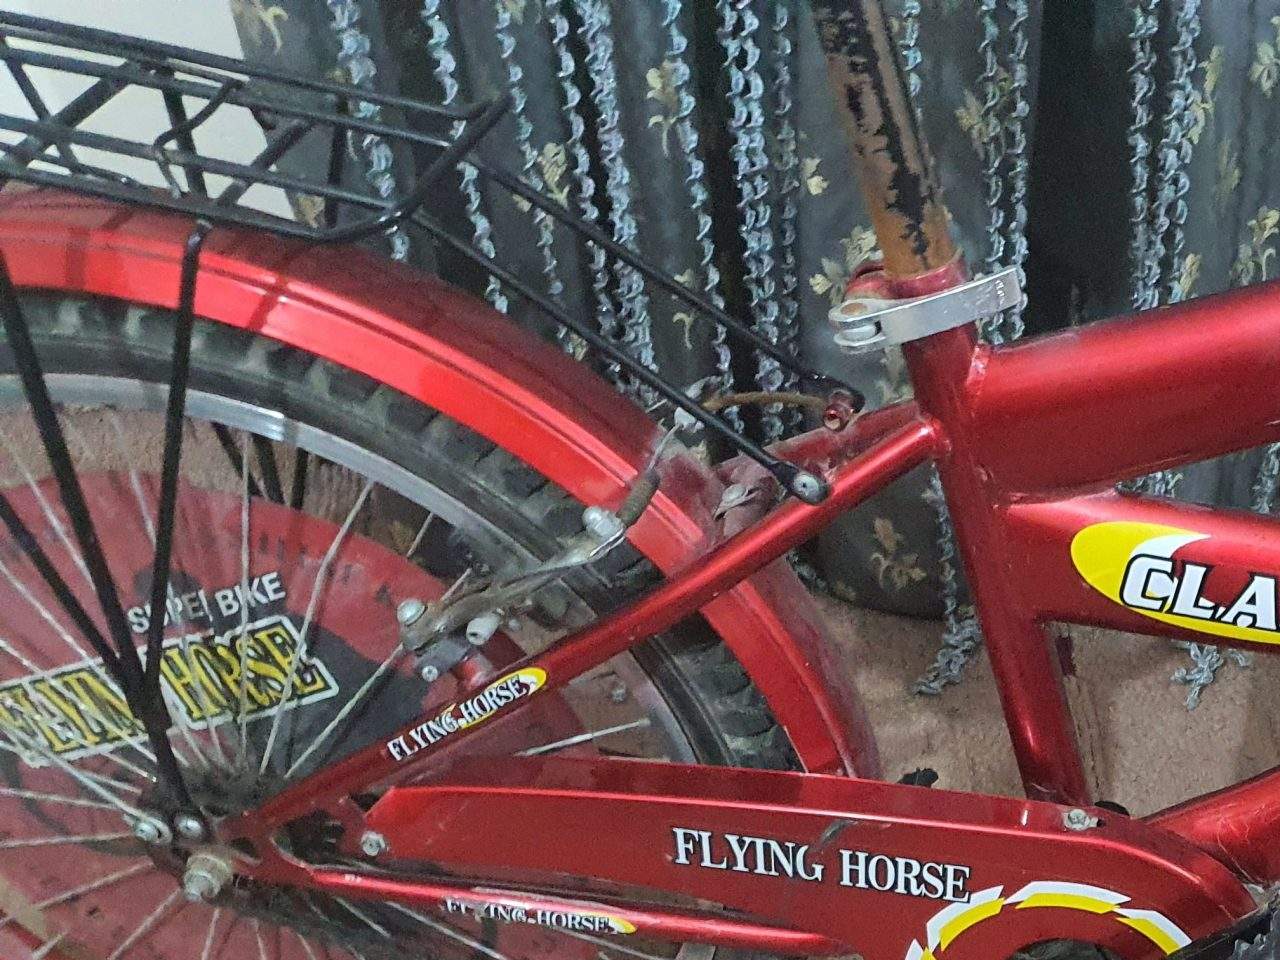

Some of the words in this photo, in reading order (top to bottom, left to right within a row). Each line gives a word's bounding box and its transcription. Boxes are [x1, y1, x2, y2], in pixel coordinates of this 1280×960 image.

[214, 571, 287, 617] BIKE
[386, 711, 460, 762] FLYING
[459, 674, 528, 724] HORSE
[672, 827, 825, 882] FLYING
[838, 848, 972, 904] HORSE
[536, 908, 611, 934] HORSE
